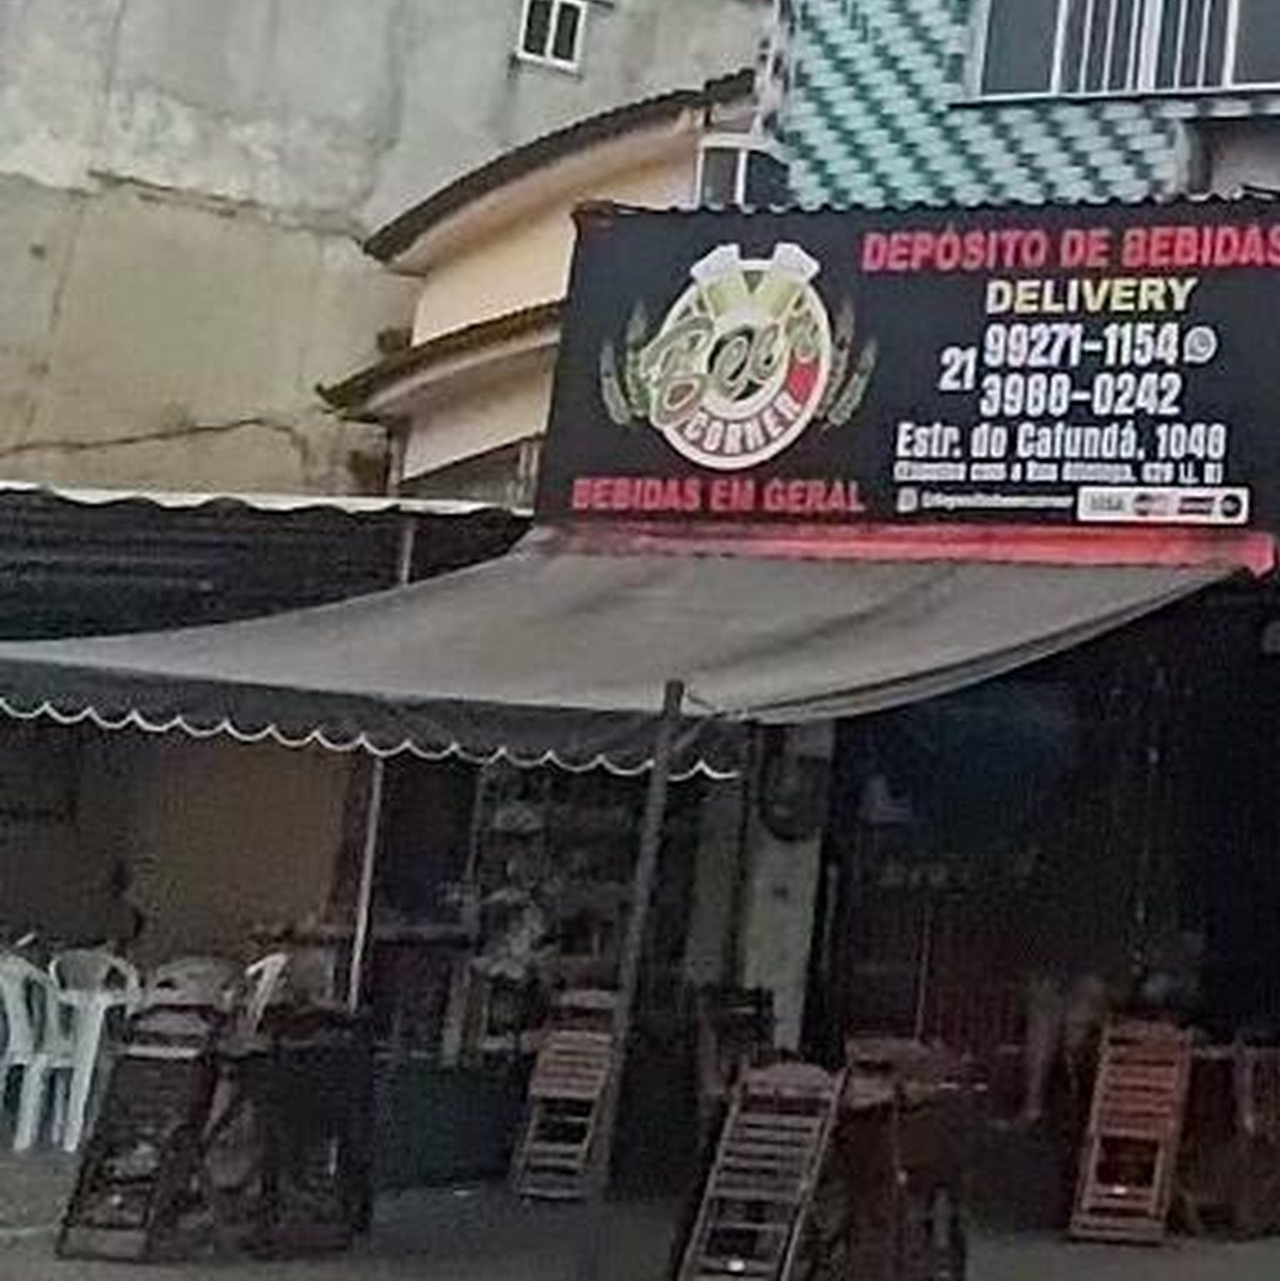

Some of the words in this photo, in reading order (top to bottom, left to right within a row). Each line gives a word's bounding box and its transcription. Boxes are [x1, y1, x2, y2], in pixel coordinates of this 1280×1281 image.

[863, 224, 1047, 270] DEPÓSITO
[1061, 229, 1110, 267] DE
[985, 276, 1198, 315] DELIVERY
[938, 346, 978, 391] 21
[983, 322, 1181, 369] 99271-1154
[896, 422, 962, 459] Estr.
[970, 423, 1008, 459] do
[572, 476, 701, 511] BEBIDAS
[710, 478, 754, 511] EM
[763, 479, 866, 512] GERAL
